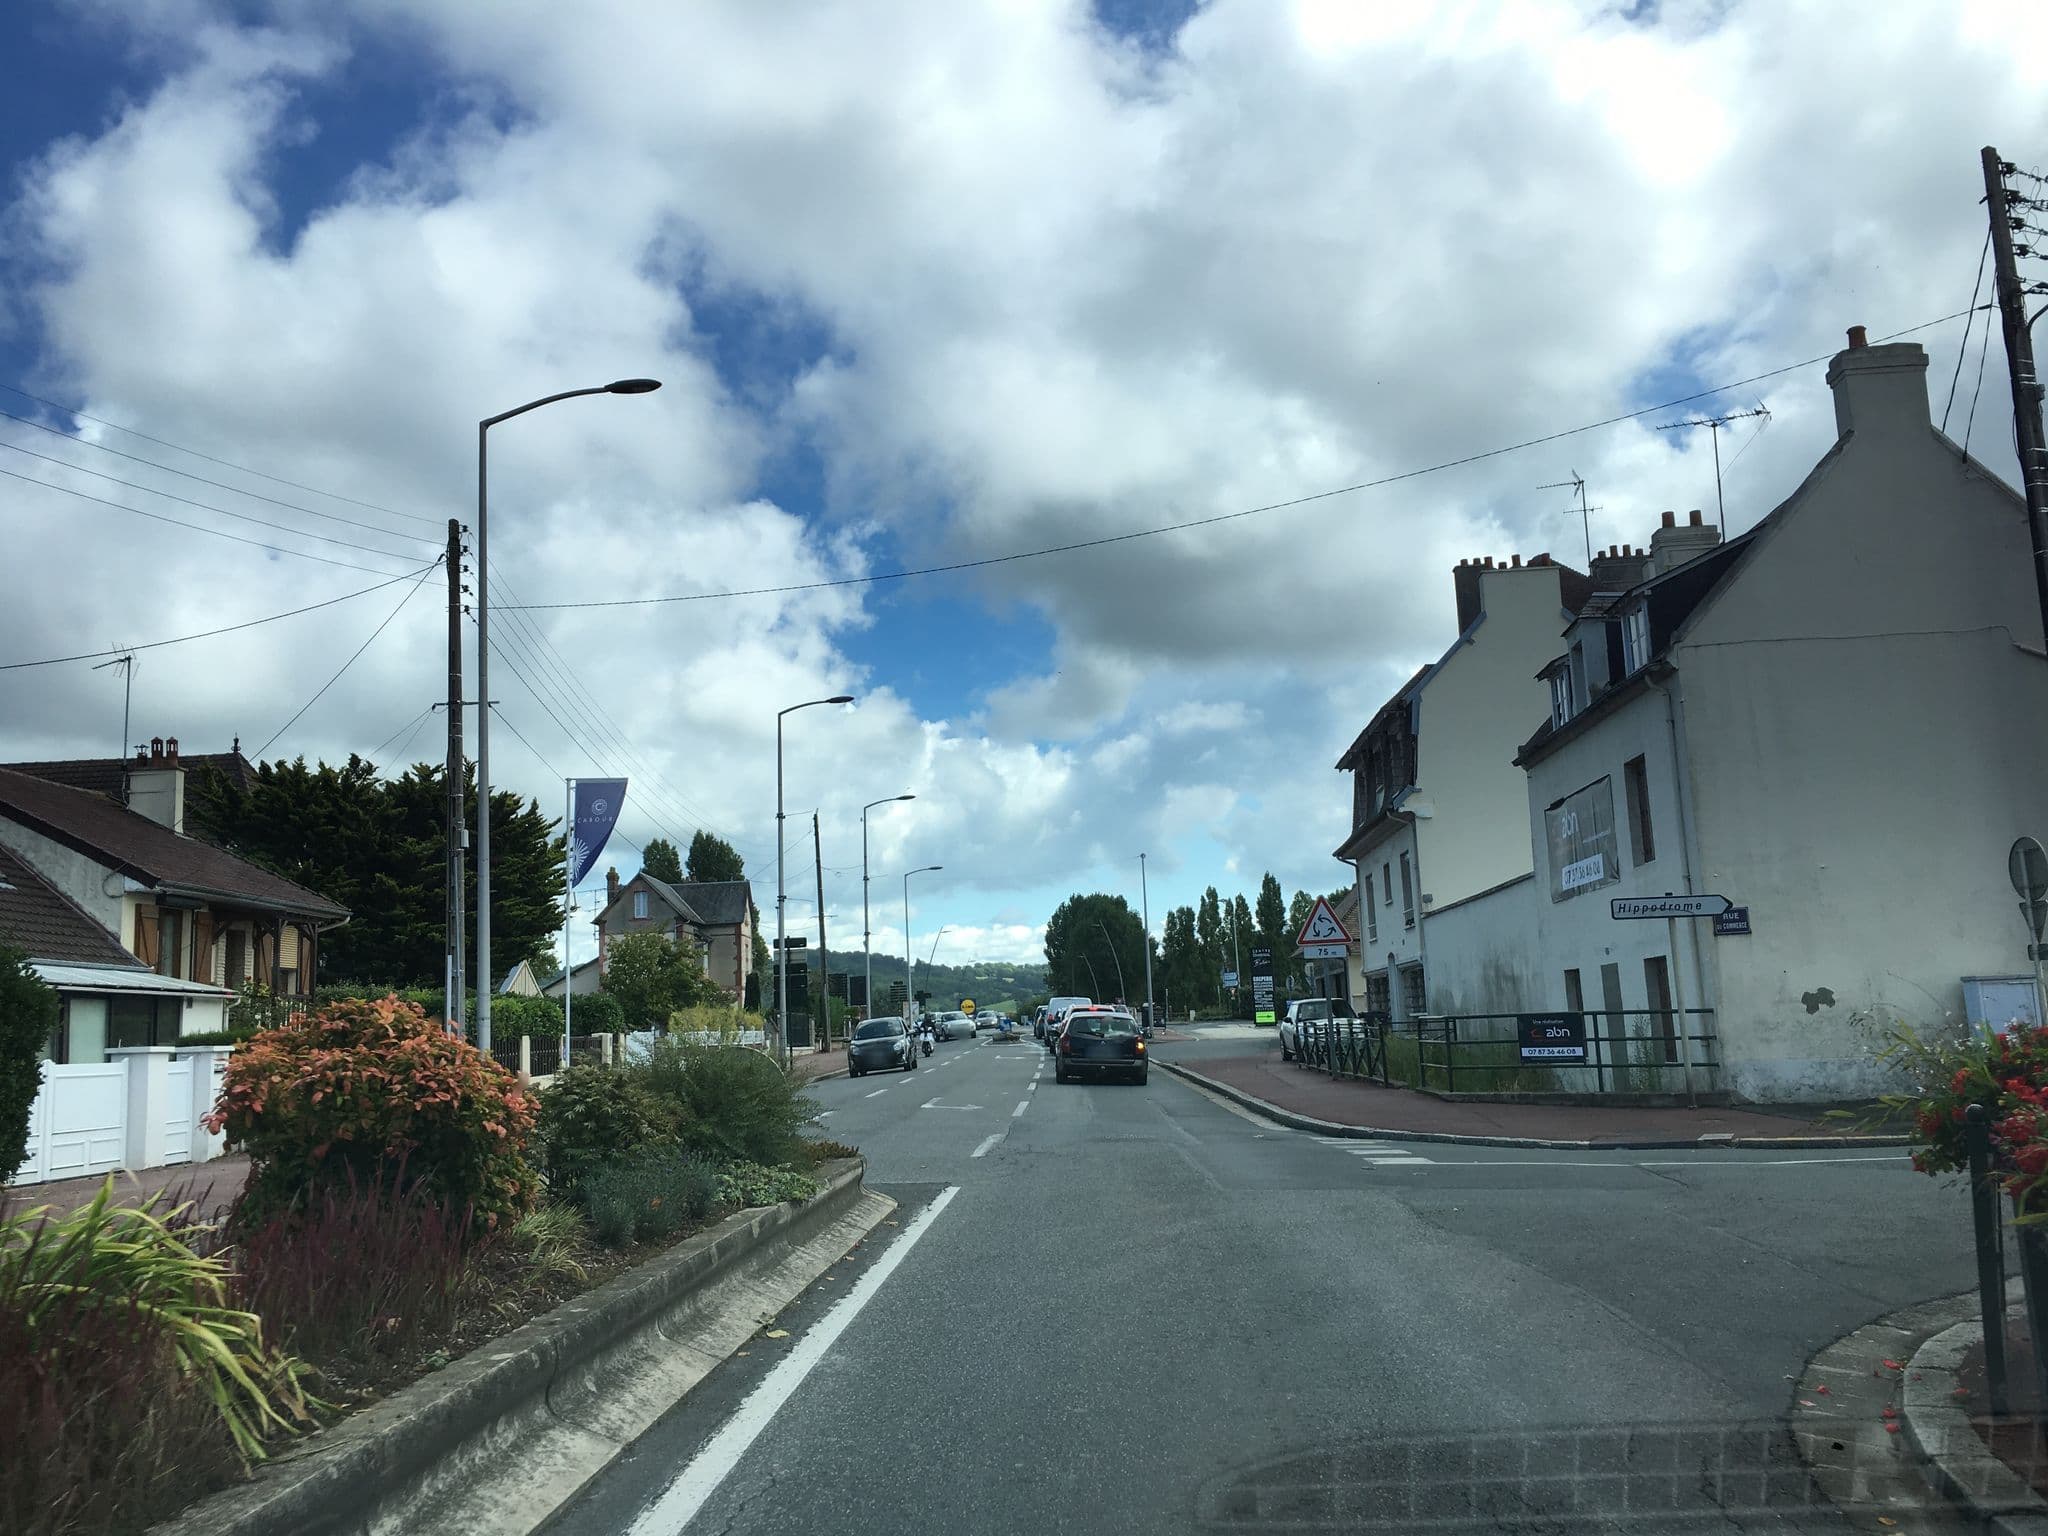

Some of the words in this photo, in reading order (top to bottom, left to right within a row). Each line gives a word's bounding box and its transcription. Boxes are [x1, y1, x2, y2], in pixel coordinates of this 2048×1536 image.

[1617, 901, 1703, 915] Hippodrome
[1722, 912, 1740, 920] RUE
[1318, 948, 1329, 956] 75
[1546, 1027, 1570, 1037] abn
